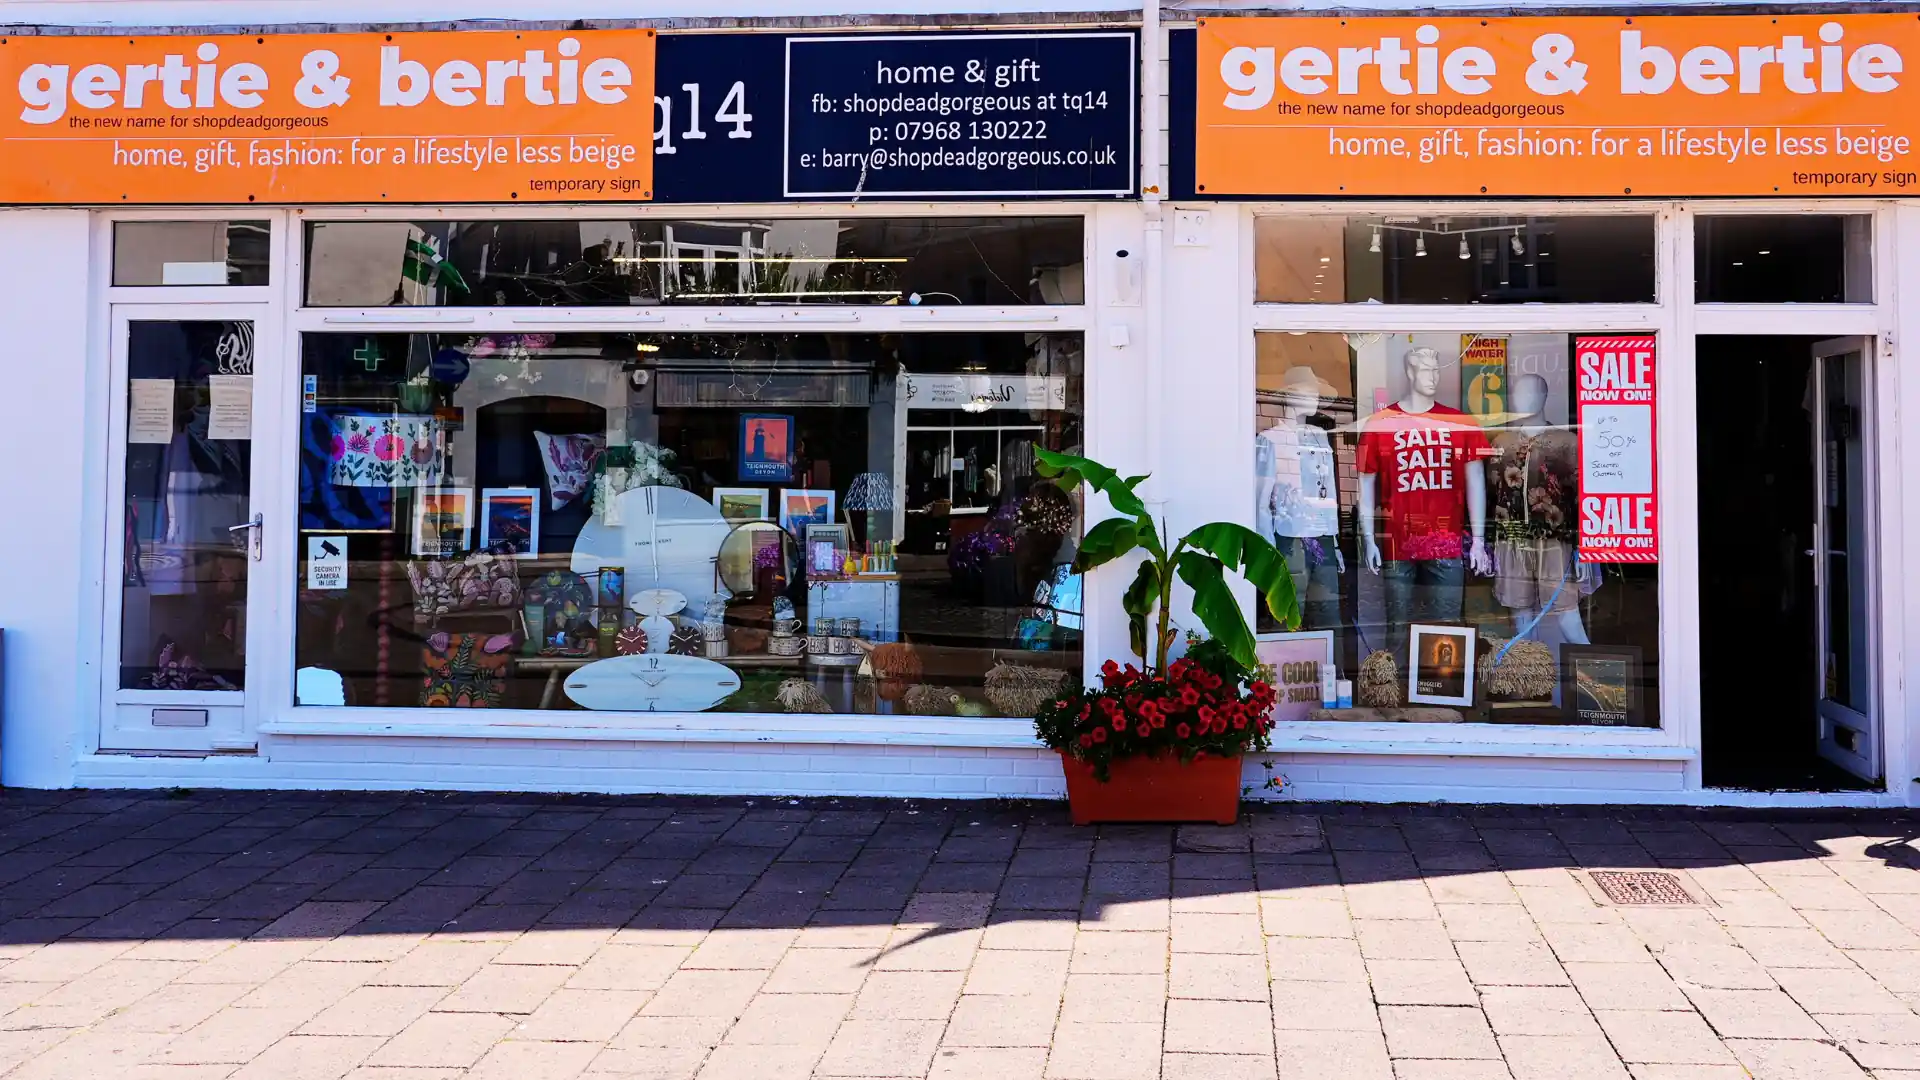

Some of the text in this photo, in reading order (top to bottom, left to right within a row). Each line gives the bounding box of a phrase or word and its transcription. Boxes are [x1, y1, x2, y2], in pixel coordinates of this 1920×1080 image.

[877, 58, 1041, 88] home & gift
[1219, 21, 1904, 110] gertie & bertie
[18, 38, 632, 124] gertie & bertie
[811, 90, 1108, 117] fb: shopdeadgorgeous at tq14
[1277, 101, 1565, 119] the new name for shopdeadgorgeous
[69, 114, 329, 131] the new name for shopdeadgorgeous
[869, 120, 1047, 146] p: 07968 130222
[113, 137, 636, 173] home, gift, fashion: for a lifestyle less beige
[1328, 127, 1910, 163] home, gift, fashion: for a lifestyle less beige
[800, 144, 1116, 173] e: barry@shopdeadgorgeous.co.uk
[530, 176, 641, 194] temporary sign
[1792, 169, 1917, 188] temporary sign
[1466, 349, 1504, 358] WATER
[1469, 339, 1499, 348] HIGH
[1580, 351, 1652, 391] SALE
[1467, 372, 1504, 422] 6
[1580, 390, 1652, 401] NOW ON!
[1393, 427, 1453, 451] SALE
[1396, 447, 1452, 472] SALE
[1396, 469, 1453, 493] SALE
[1582, 496, 1653, 535] SALE
[1581, 536, 1654, 548] NOW ON!
[649, 657, 659, 669] 12
[1579, 711, 1626, 720] TEIGNMOUTH
